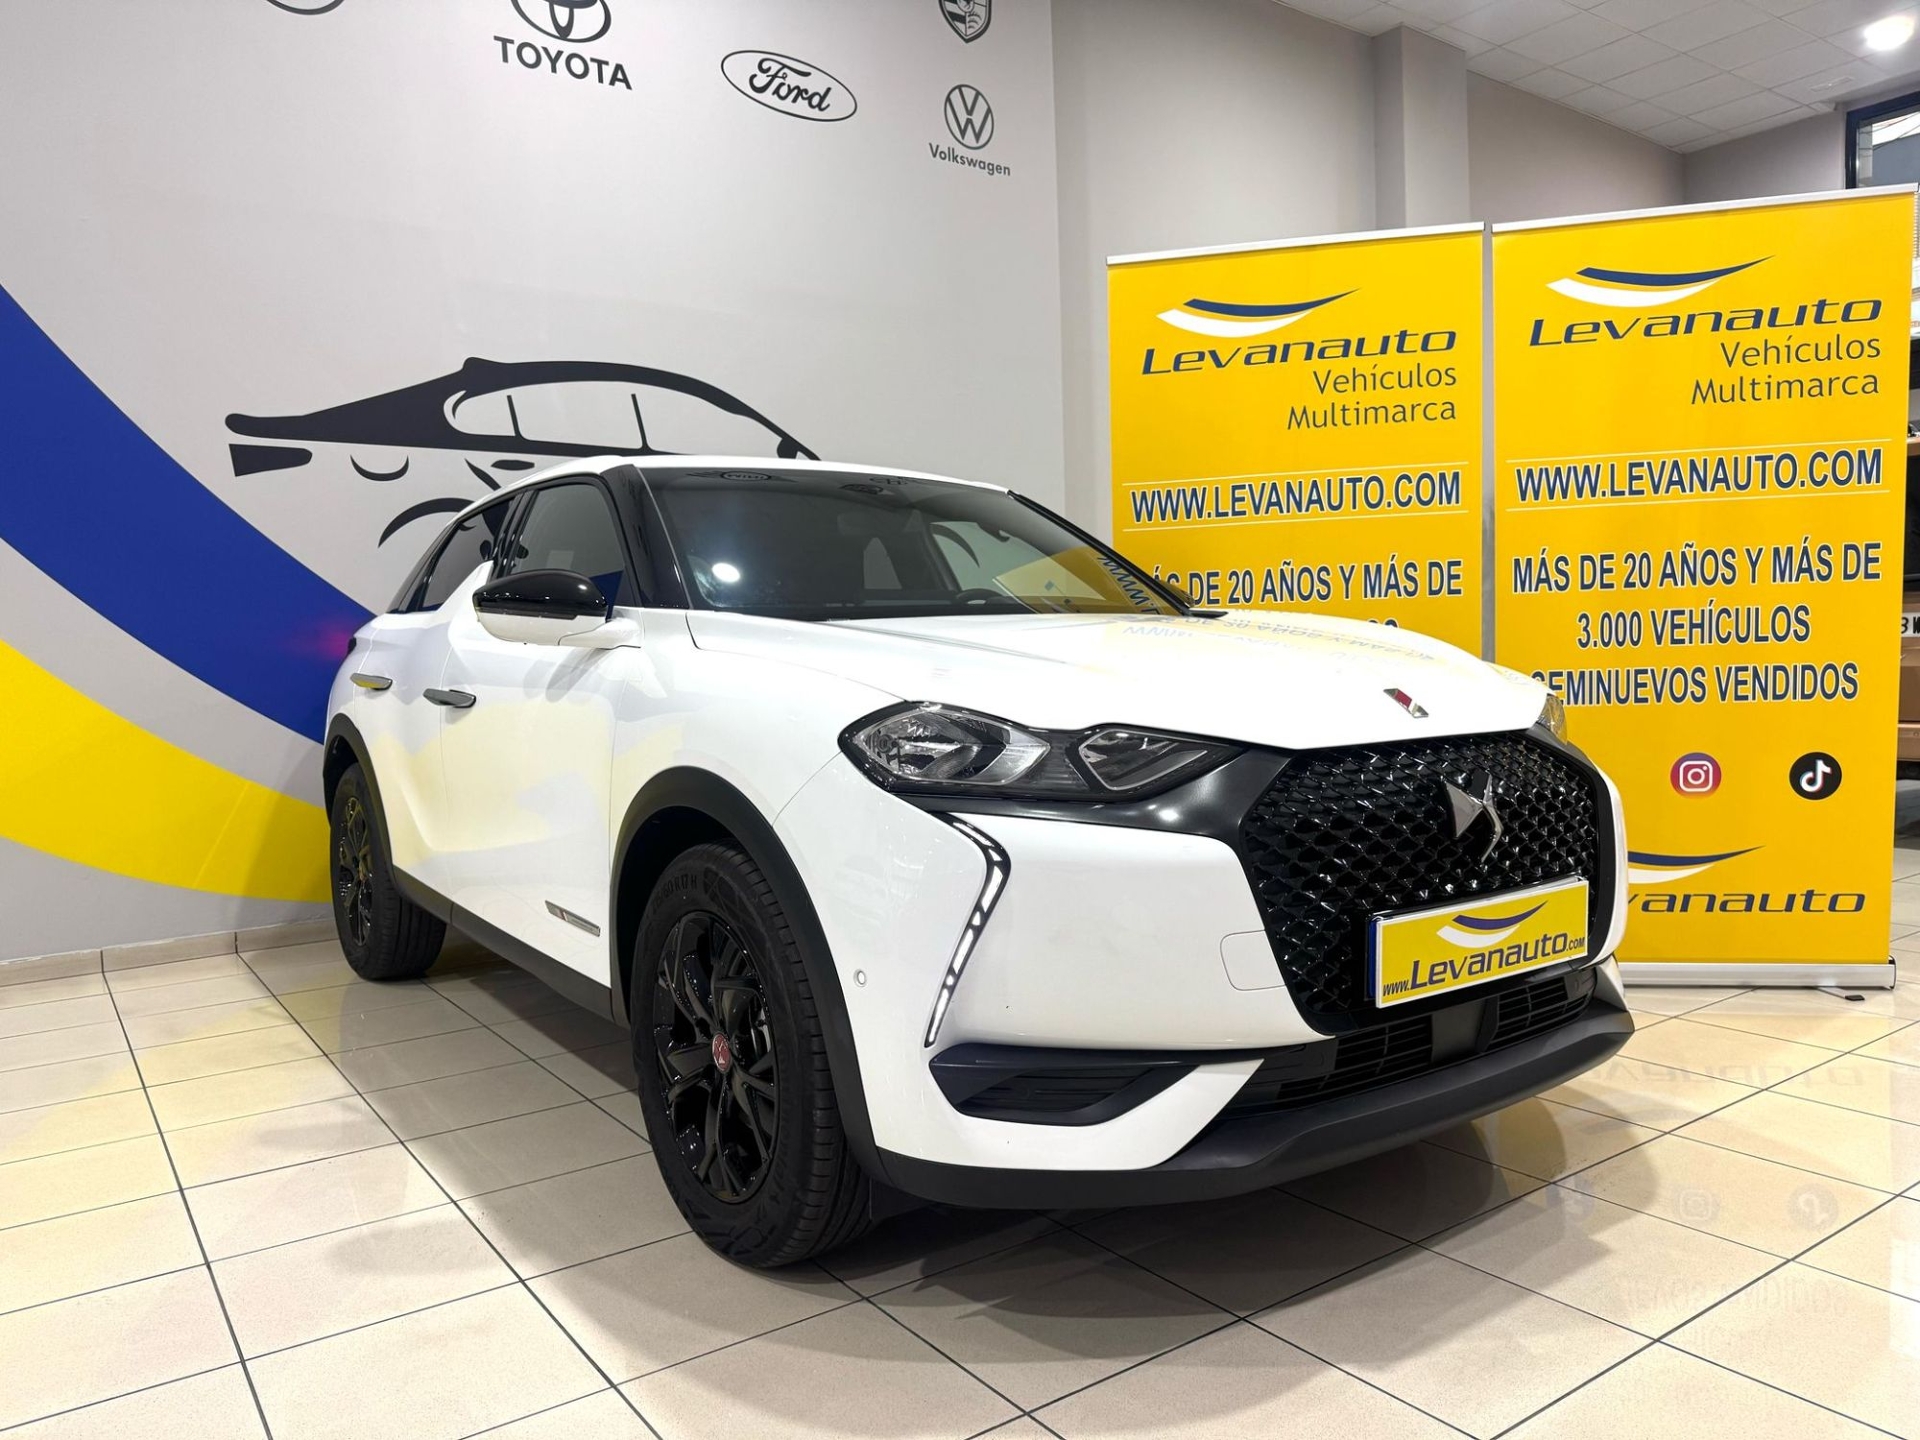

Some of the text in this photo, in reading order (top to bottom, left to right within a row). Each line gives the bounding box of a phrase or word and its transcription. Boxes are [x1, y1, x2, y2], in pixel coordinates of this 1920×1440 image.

[493, 35, 632, 90] TOYOTA
[748, 57, 832, 111] Ford
[929, 142, 1011, 176] Volkswagen
[1529, 298, 1882, 347] Levanauto
[1142, 329, 1457, 375] Levanauto
[1720, 333, 1881, 368] Vehículos
[1313, 362, 1457, 395] Vehículos
[1691, 373, 1880, 405] Multimarca
[1287, 401, 1456, 430] Multimarca
[1131, 471, 1461, 523] WWW.LEVANAUTO.COM
[1515, 448, 1882, 502] WWW.LEVANAUTO.COM
[1189, 571, 1220, 605] DE
[1228, 570, 1254, 604] 20
[1261, 559, 1331, 603] AÑOS
[1339, 564, 1356, 600] Y
[1363, 553, 1419, 599] MÁS
[1428, 560, 1463, 596] DE
[1512, 536, 1882, 594] MÁS DE 20 AÑOS Y MÁS DE
[1577, 600, 1811, 649] 3.000 VEHÍCULOS
[1715, 663, 1859, 702] VENDIDOS
